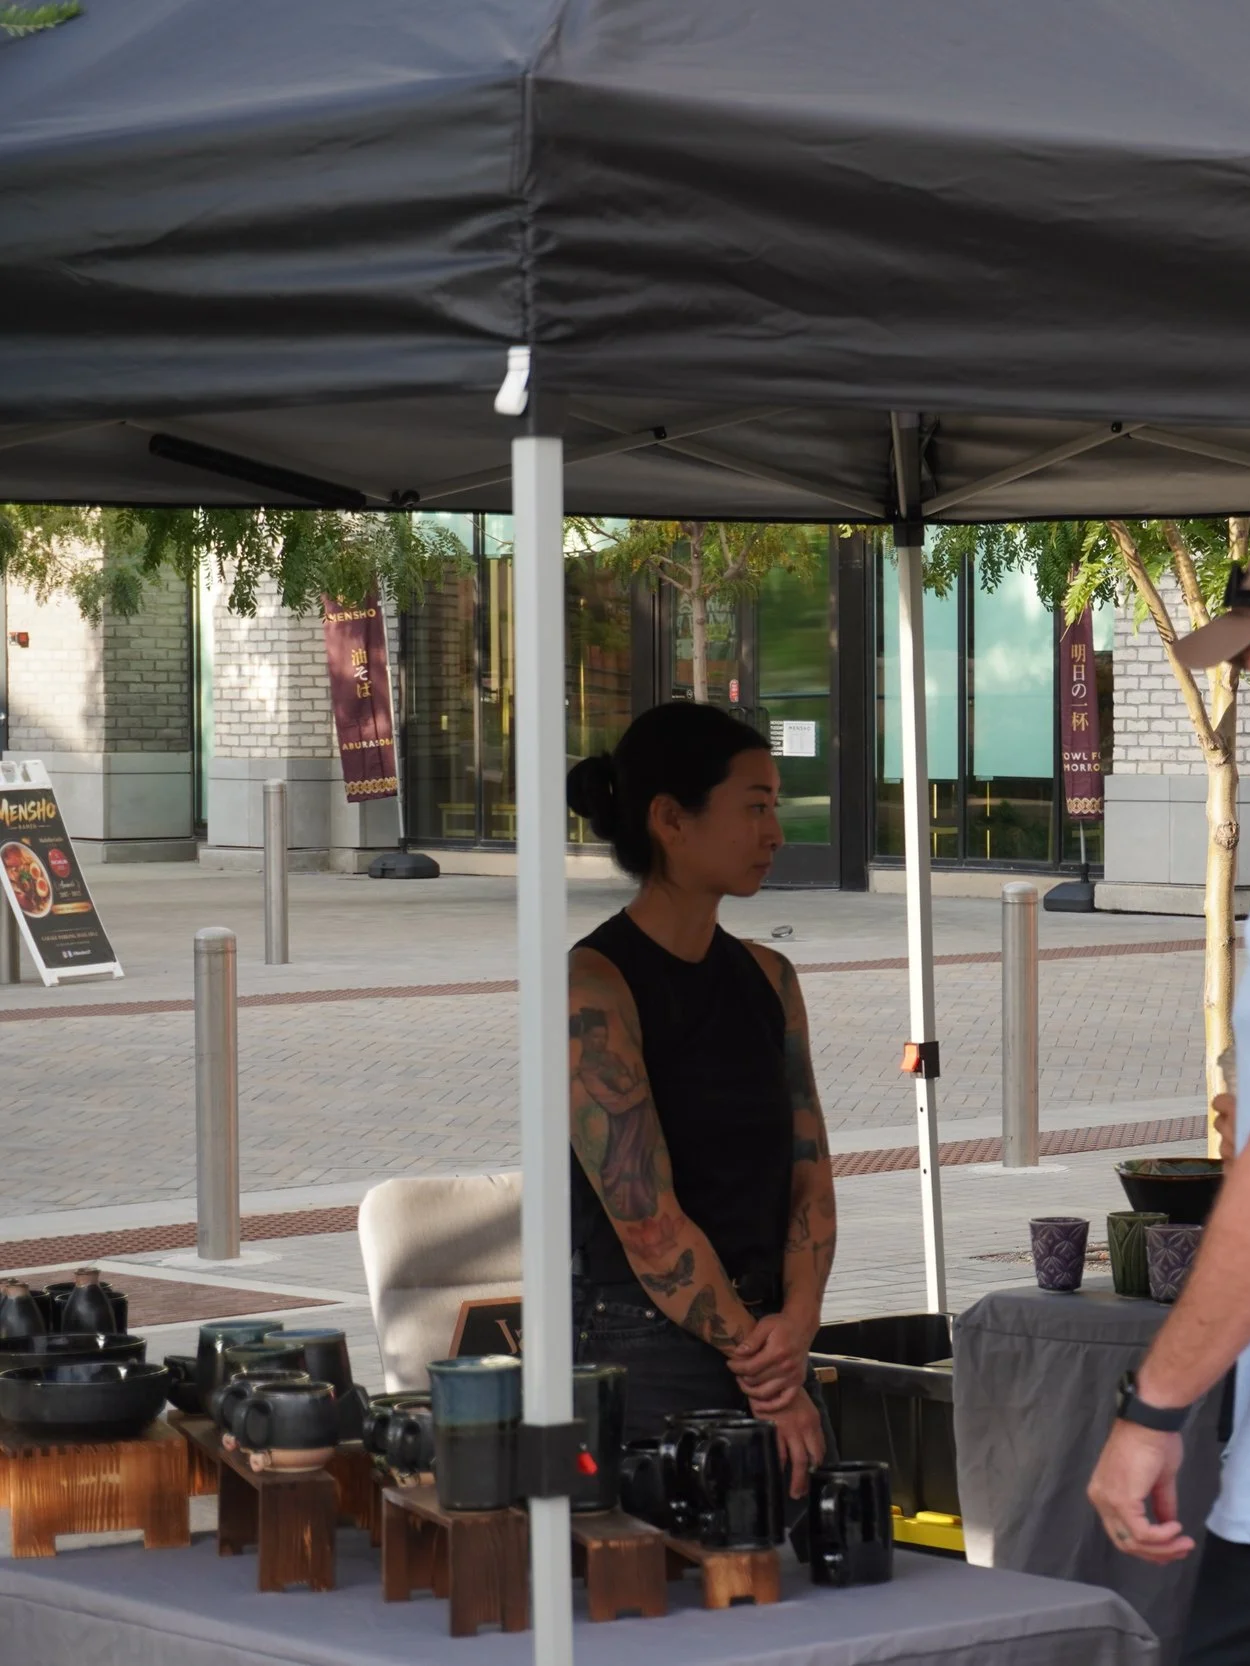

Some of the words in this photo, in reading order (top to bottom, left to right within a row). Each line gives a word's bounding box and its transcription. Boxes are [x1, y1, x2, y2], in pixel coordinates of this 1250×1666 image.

[327, 608, 376, 622] MENSHO
[351, 648, 372, 699] 油そば
[1071, 643, 1089, 732] 明日の一杯
[1063, 751, 1088, 761] OWL
[0, 798, 56, 826] MENSHO
